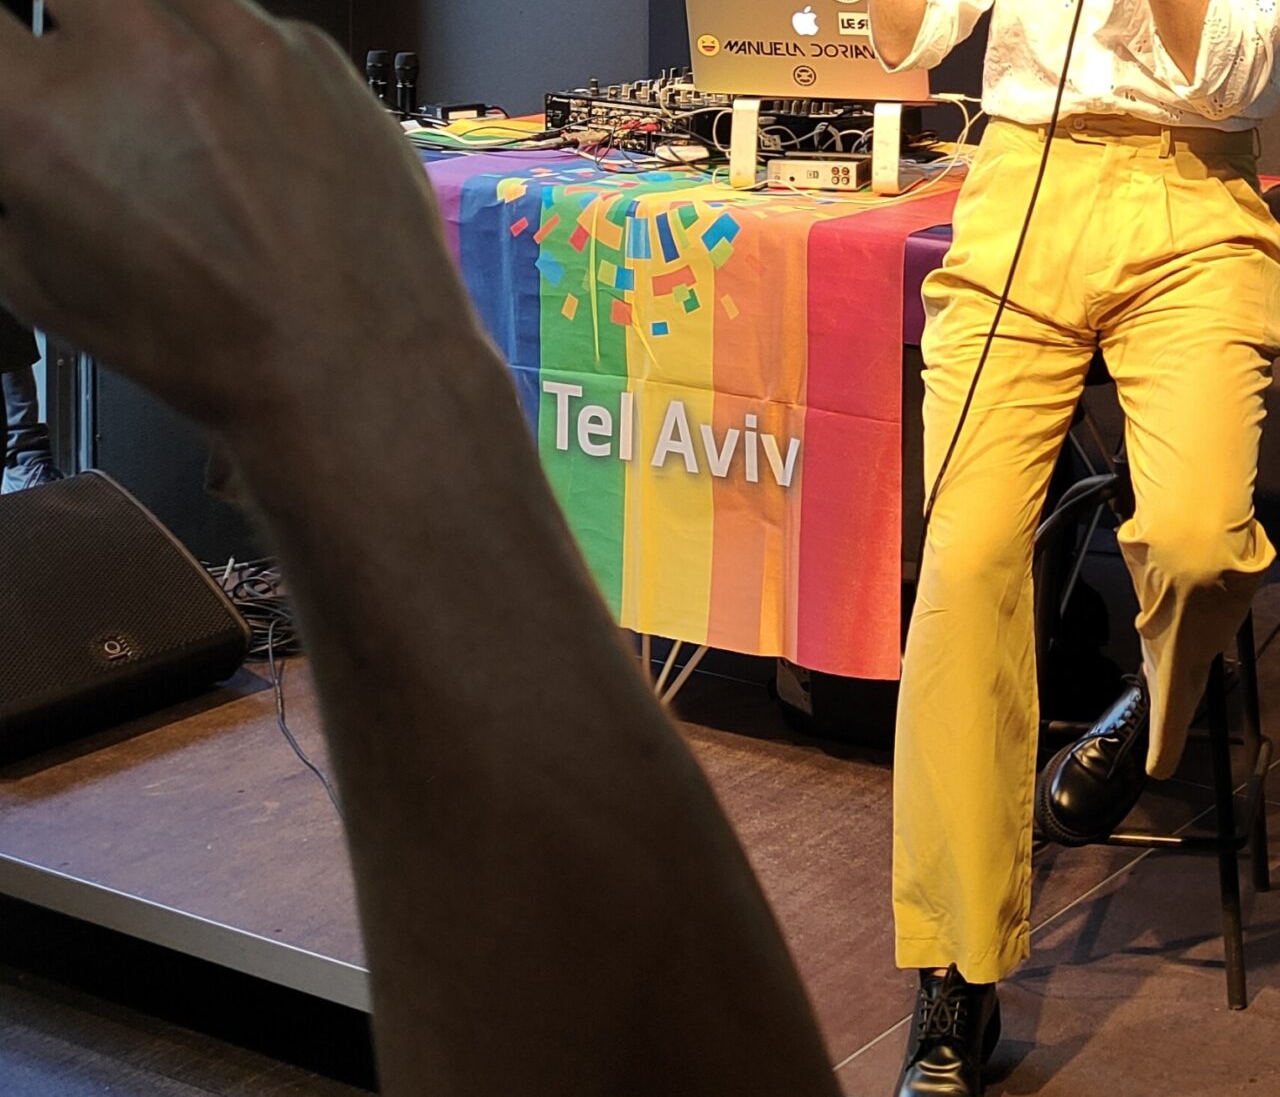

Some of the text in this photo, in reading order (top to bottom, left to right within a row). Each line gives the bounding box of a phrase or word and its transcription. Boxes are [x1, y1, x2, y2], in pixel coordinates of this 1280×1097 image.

[724, 40, 806, 57] MANUELA
[542, 380, 801, 488] Tel Aviv
